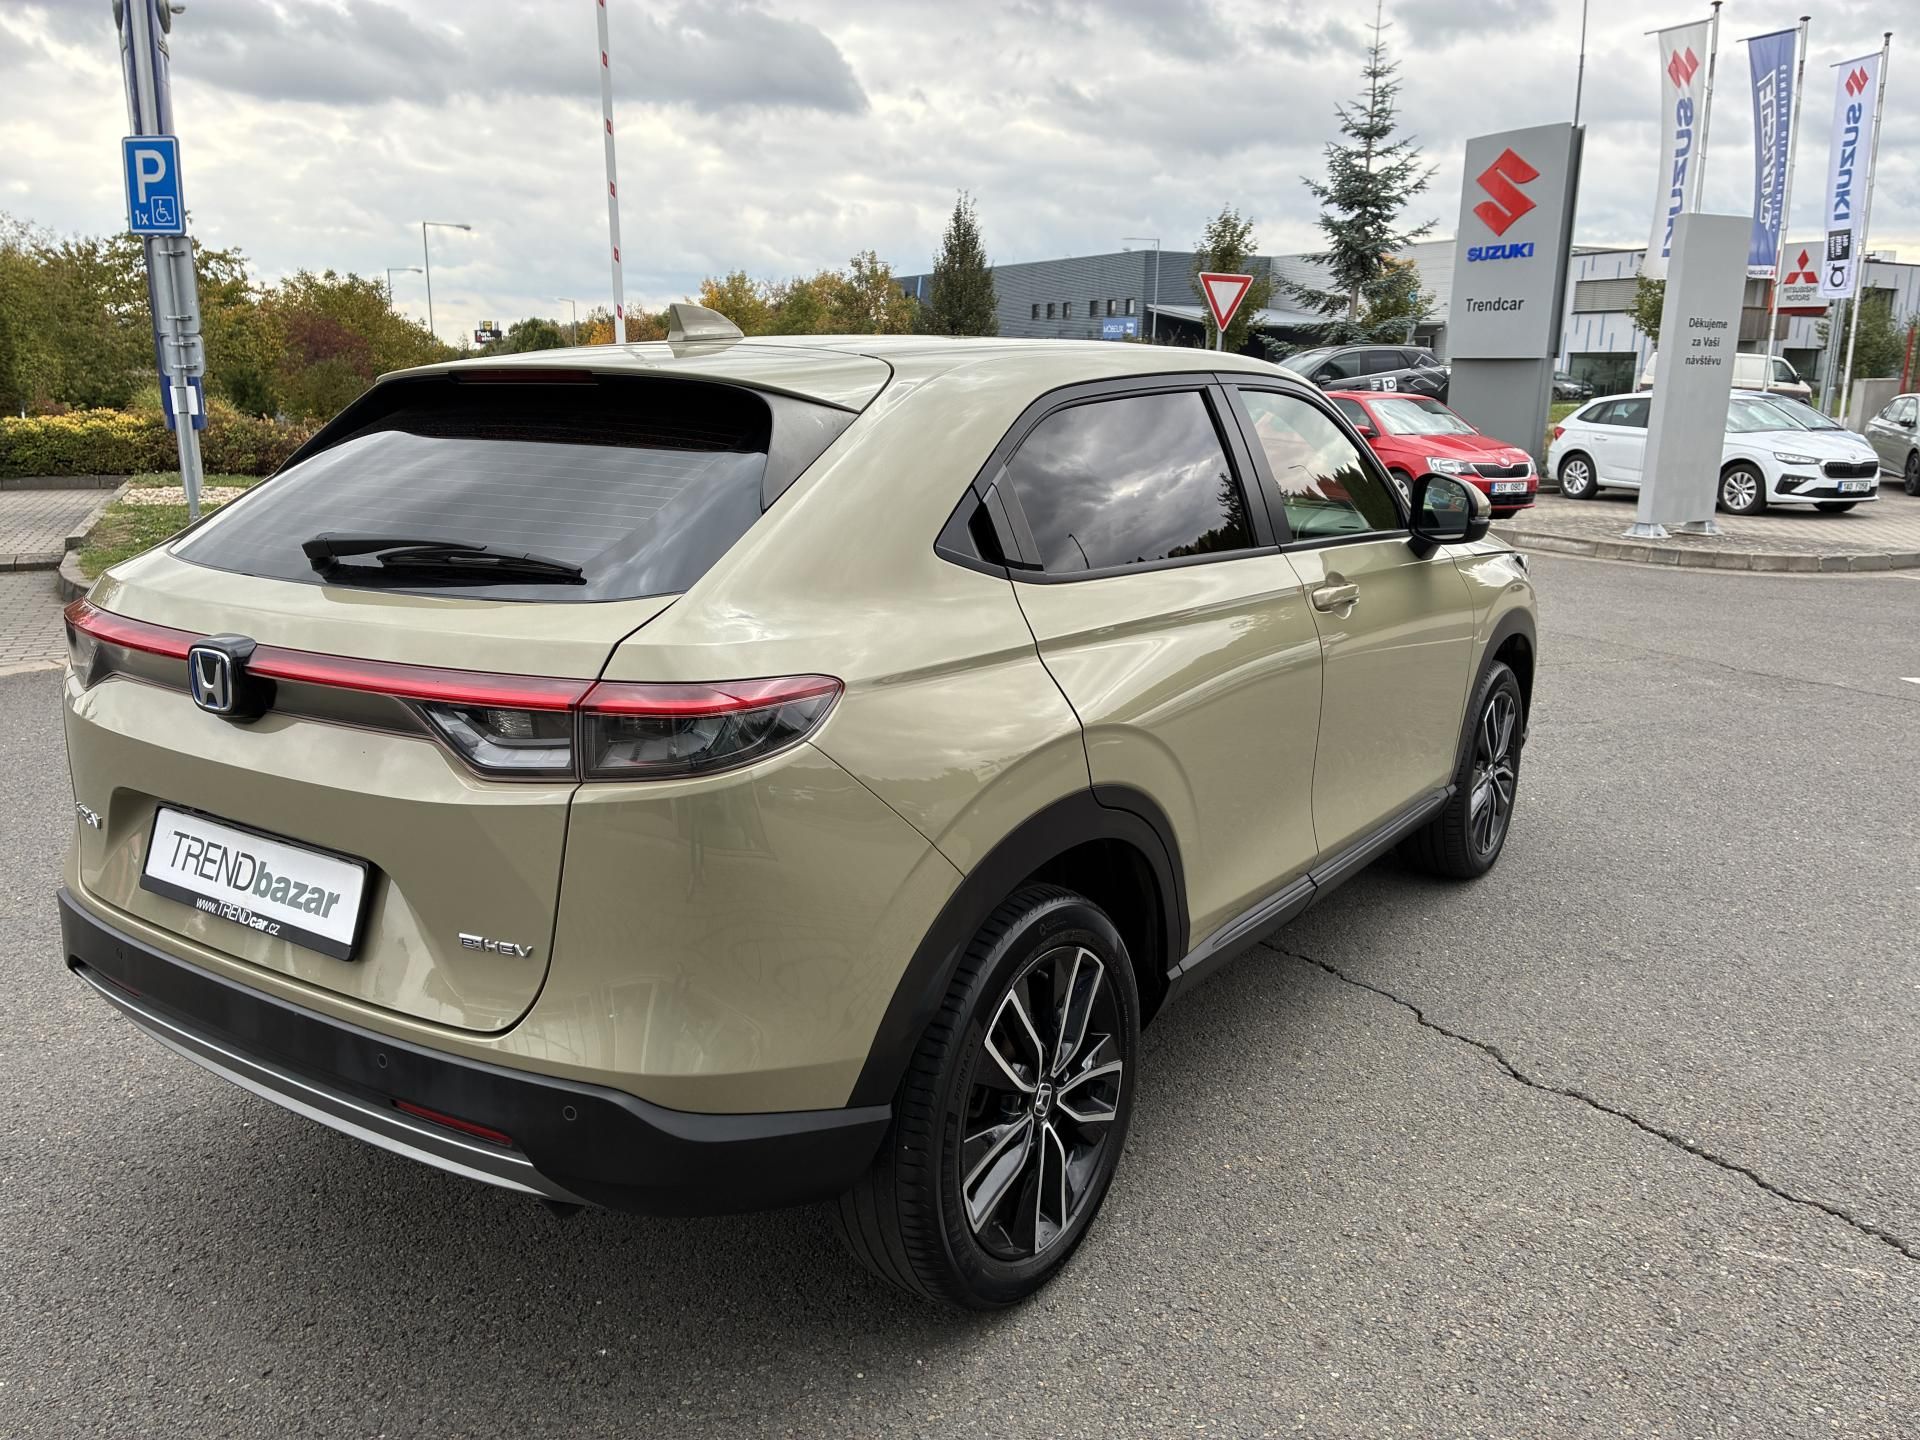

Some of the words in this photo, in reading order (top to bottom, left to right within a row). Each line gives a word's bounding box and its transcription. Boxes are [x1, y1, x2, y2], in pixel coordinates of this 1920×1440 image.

[134, 149, 166, 204] P
[135, 210, 149, 225] 1x
[1467, 242, 1535, 262] SUZUKI
[1466, 297, 1525, 312] Trendcar
[1689, 317, 1728, 331] Děkujeme
[1691, 338, 1702, 347] za
[1685, 354, 1722, 366] návštěvu
[169, 830, 341, 919] TRENDbazar
[196, 897, 281, 936] www.TRENDcar.cz
